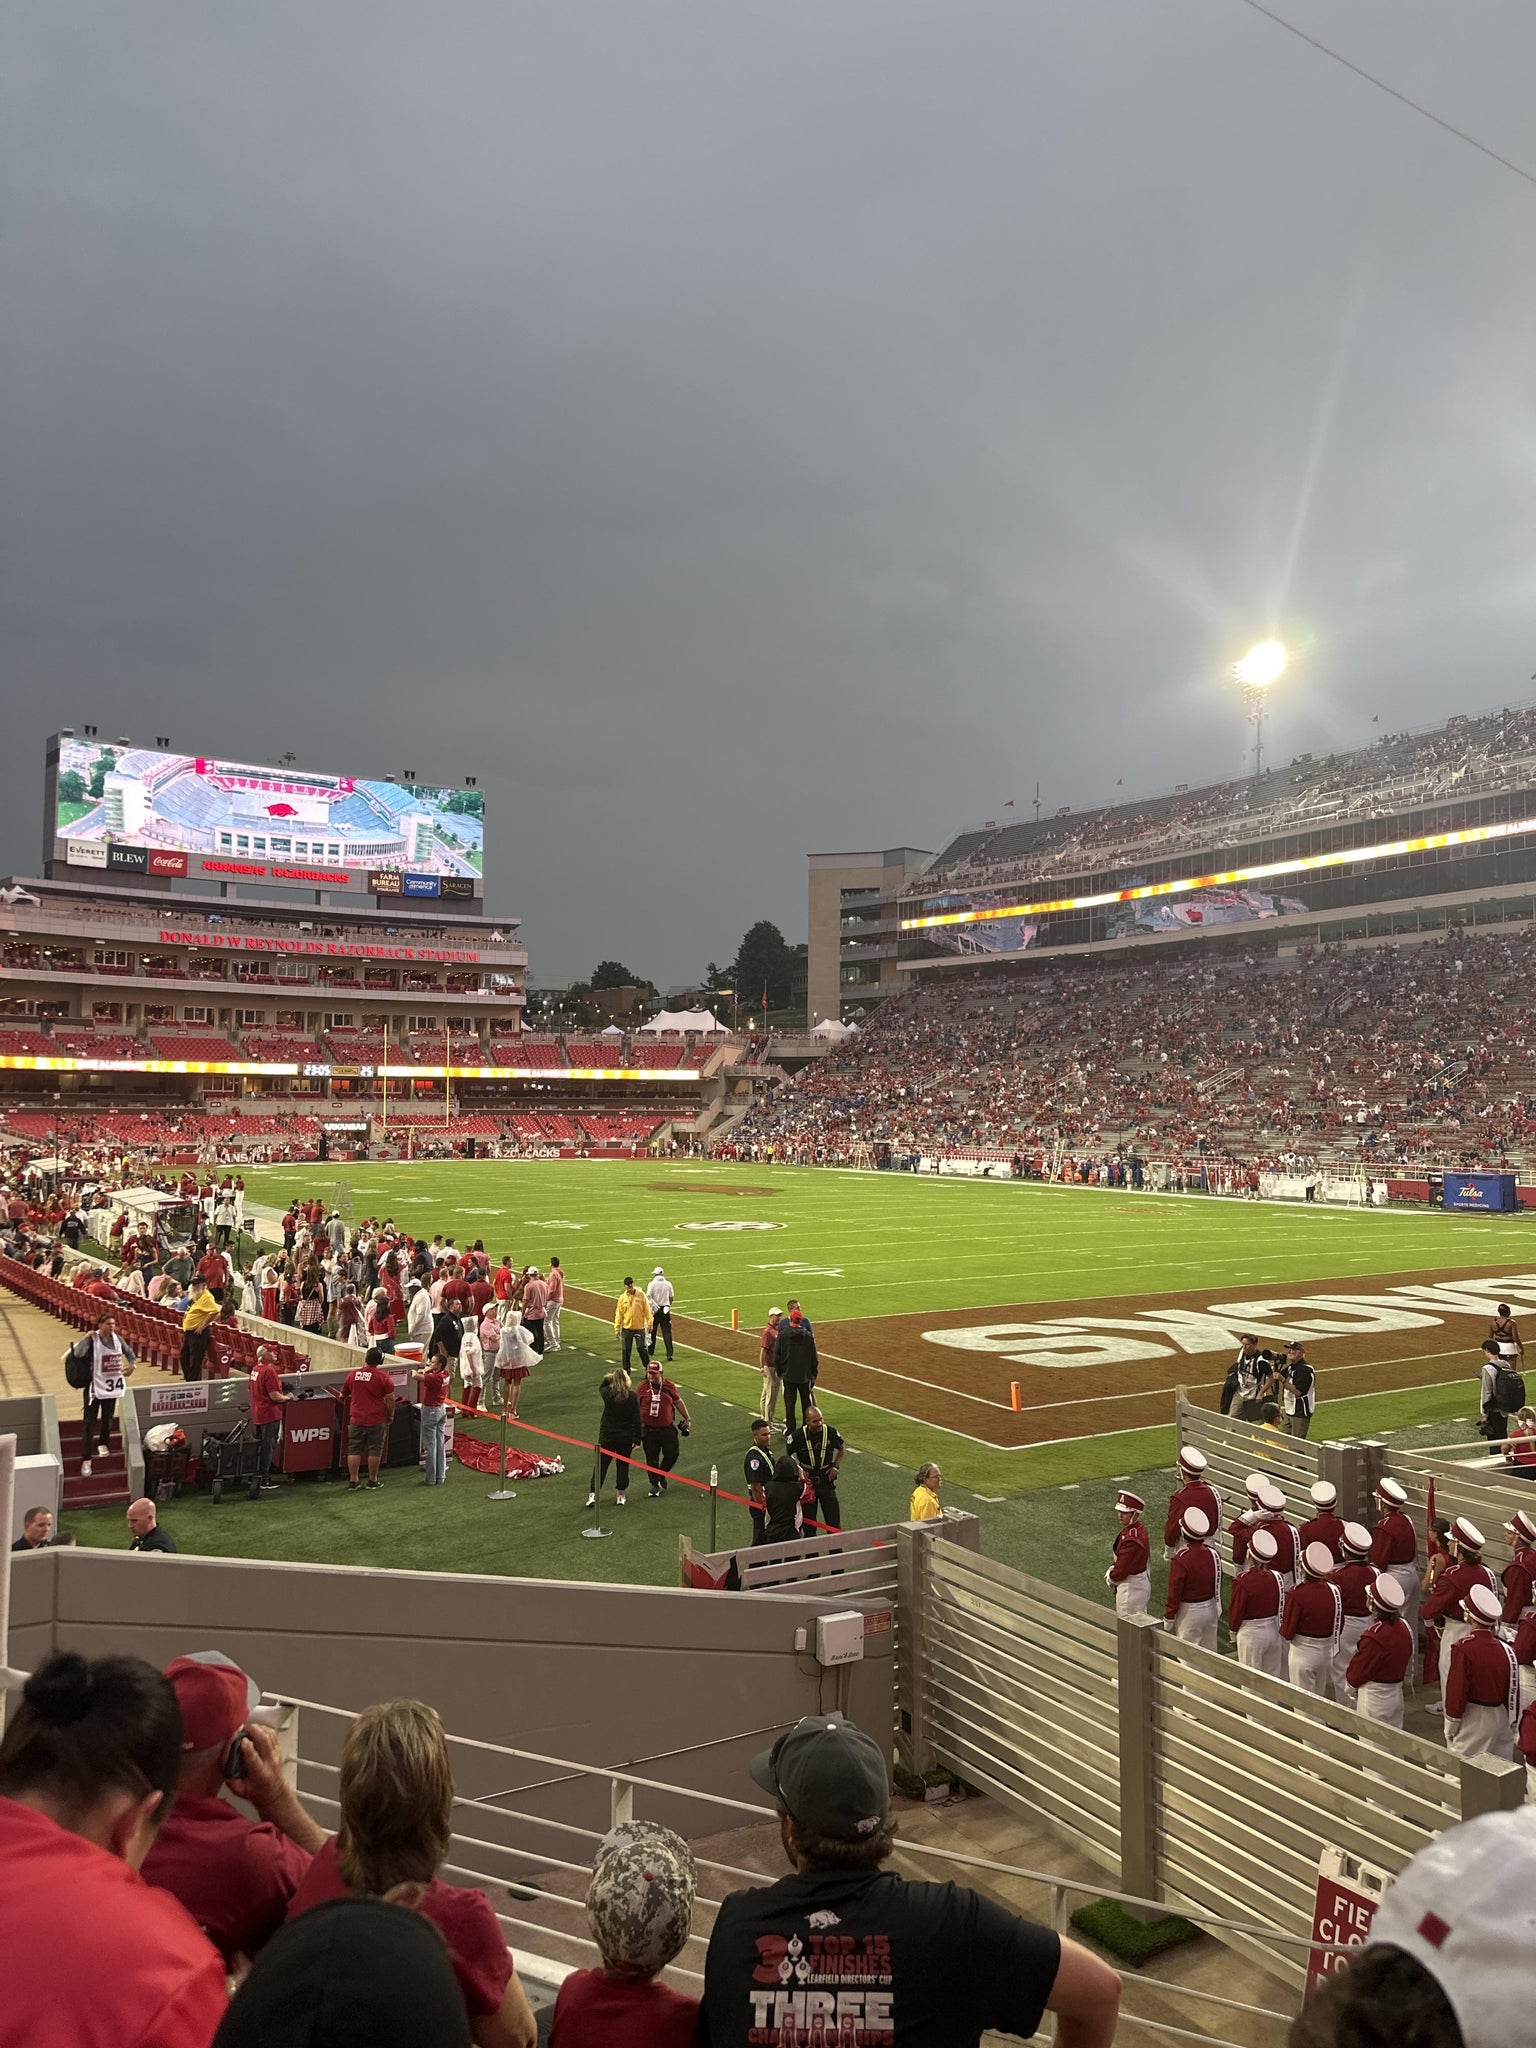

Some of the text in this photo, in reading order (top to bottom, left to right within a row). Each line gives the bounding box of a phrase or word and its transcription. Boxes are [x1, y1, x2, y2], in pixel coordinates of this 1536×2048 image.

[112, 851, 145, 864] BLEW
[202, 860, 350, 883] ARKANSAS RAZORBACKS
[372, 879, 400, 887] BUREAU
[442, 880, 472, 889] SARACEN
[159, 930, 480, 963] DONALD W REYNOLDS RAZORBACK STADIUM
[324, 1122, 367, 1130] ARKANSAS
[1458, 1187, 1484, 1198] Tulsa
[105, 1377, 125, 1392] 34
[290, 1427, 330, 1443] WPS
[1119, 1494, 1125, 1503] A
[1333, 1895, 1370, 1932] FIE
[809, 1935, 891, 1954] TOP 15
[809, 1955, 893, 1974] FINISHES
[807, 1974, 893, 1985] LEARFIELD DIRECTORS' CUP
[750, 1991, 895, 2030] THREE
